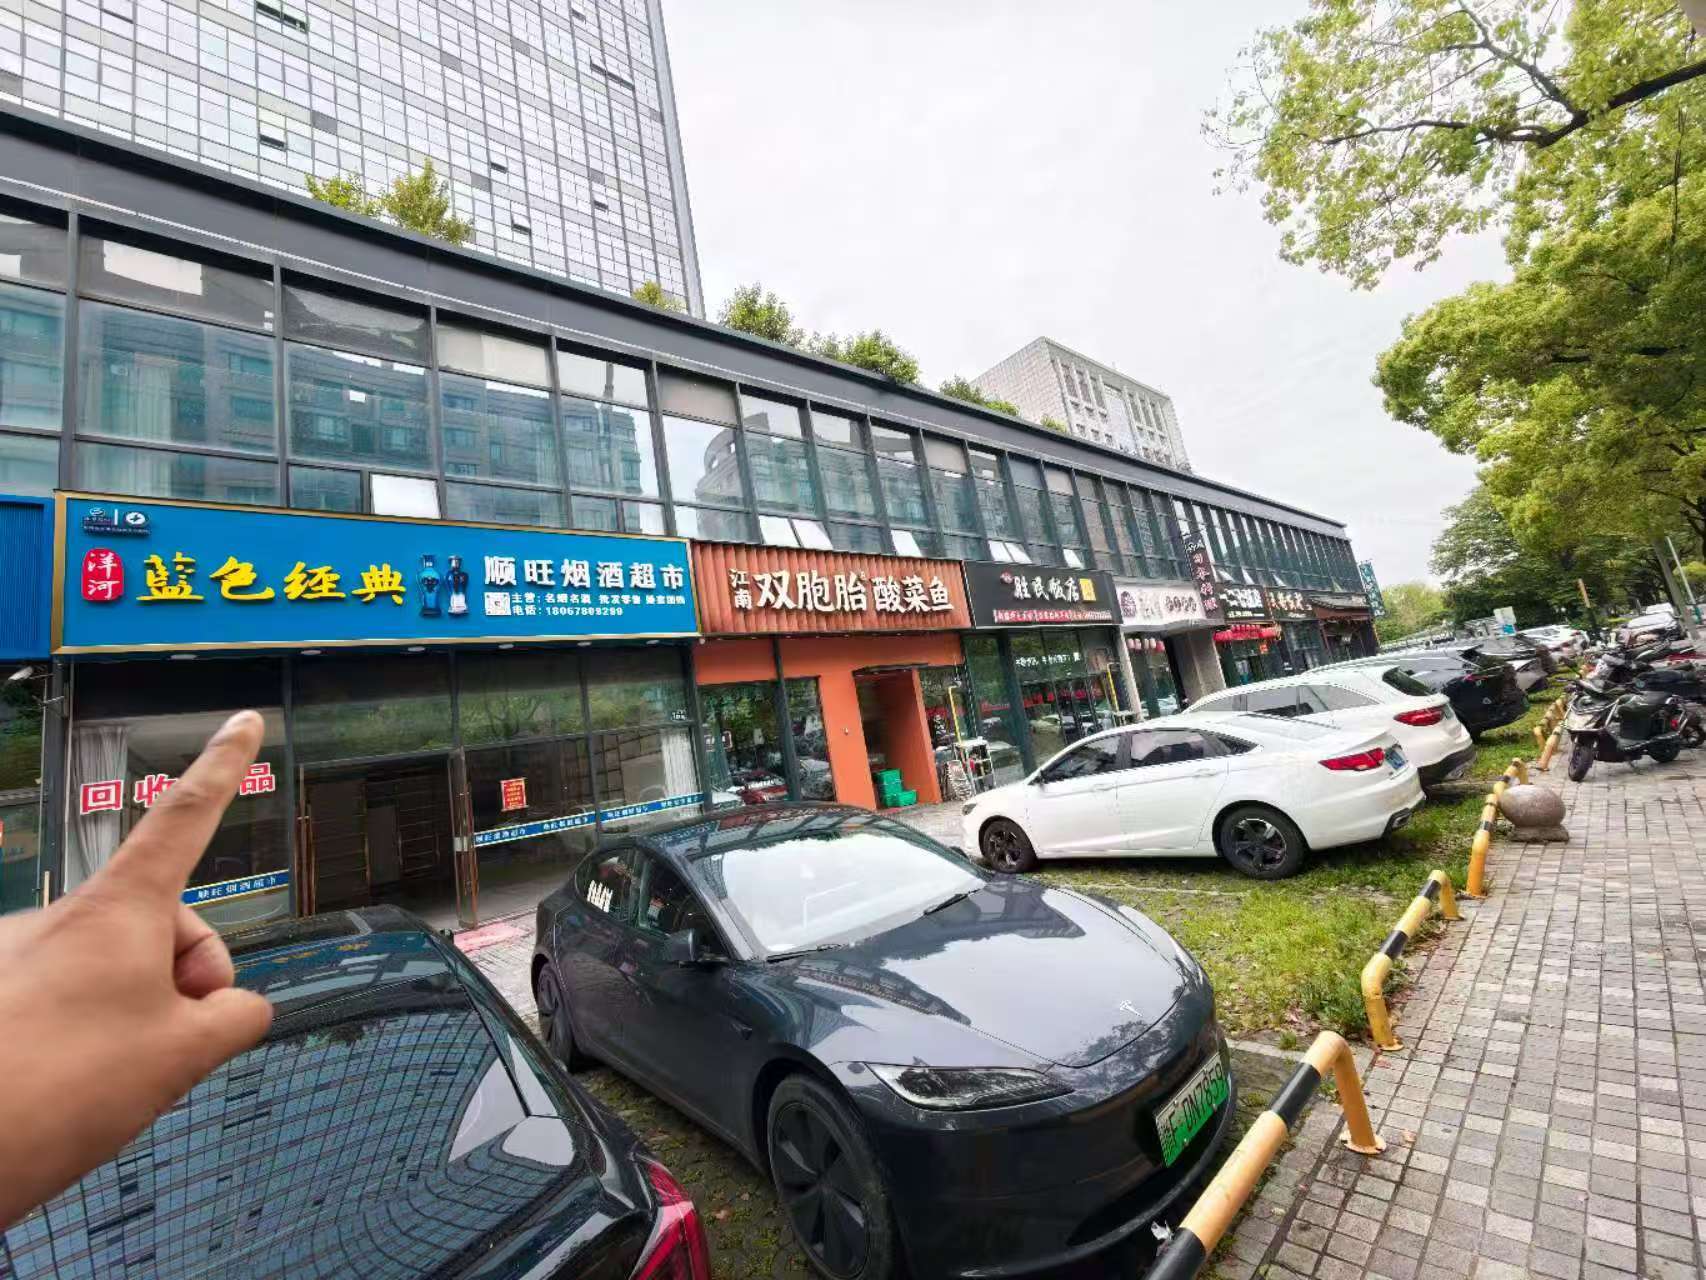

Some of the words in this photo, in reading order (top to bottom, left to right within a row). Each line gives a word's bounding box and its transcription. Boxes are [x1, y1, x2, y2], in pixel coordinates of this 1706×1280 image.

[87, 551, 119, 600] 洋河
[484, 556, 684, 589] 顺旺烟酒超市
[729, 568, 752, 610] 江南
[753, 570, 954, 613] 双胞胎酸菜鱼
